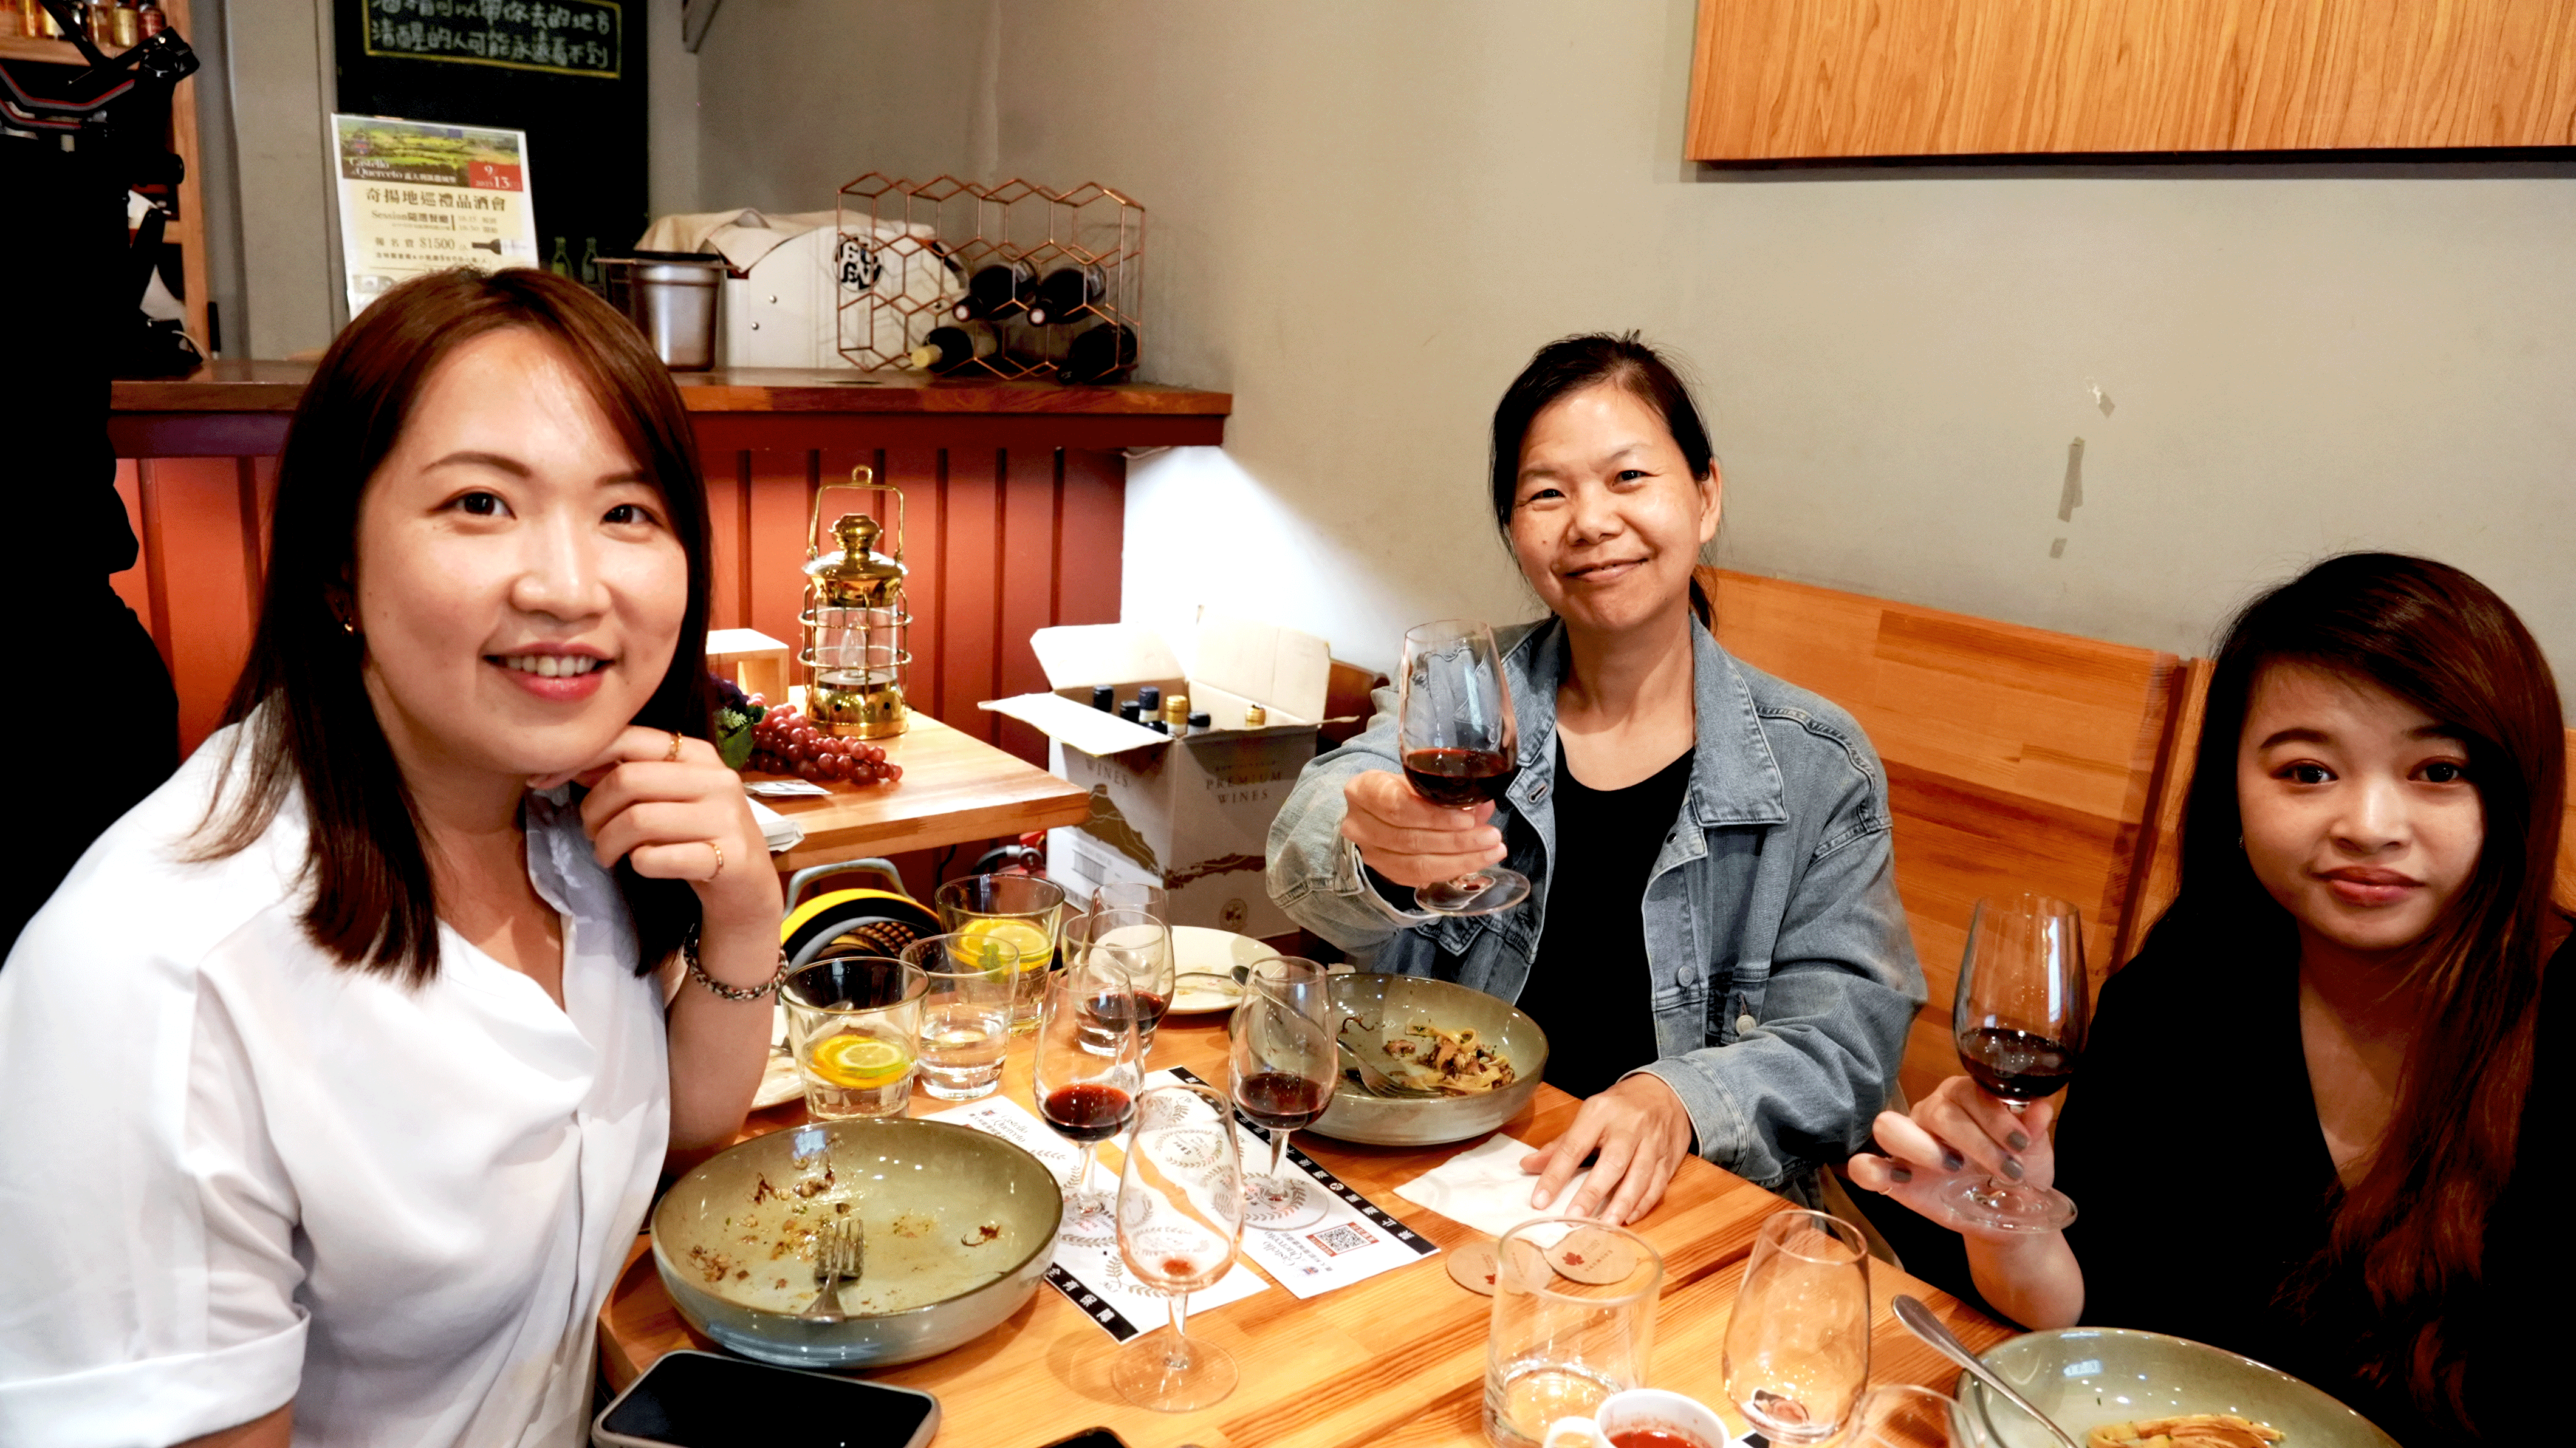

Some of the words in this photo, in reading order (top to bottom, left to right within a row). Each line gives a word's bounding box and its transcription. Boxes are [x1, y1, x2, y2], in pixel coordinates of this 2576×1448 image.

[372, 17, 608, 69] 清醒的人可能永遠看不到
[1205, 771, 1281, 790] PREMIUM
[1218, 789, 1269, 805] WINES
[1263, 1241, 1295, 1266] Castello
[1264, 1231, 1302, 1259] Querceto
